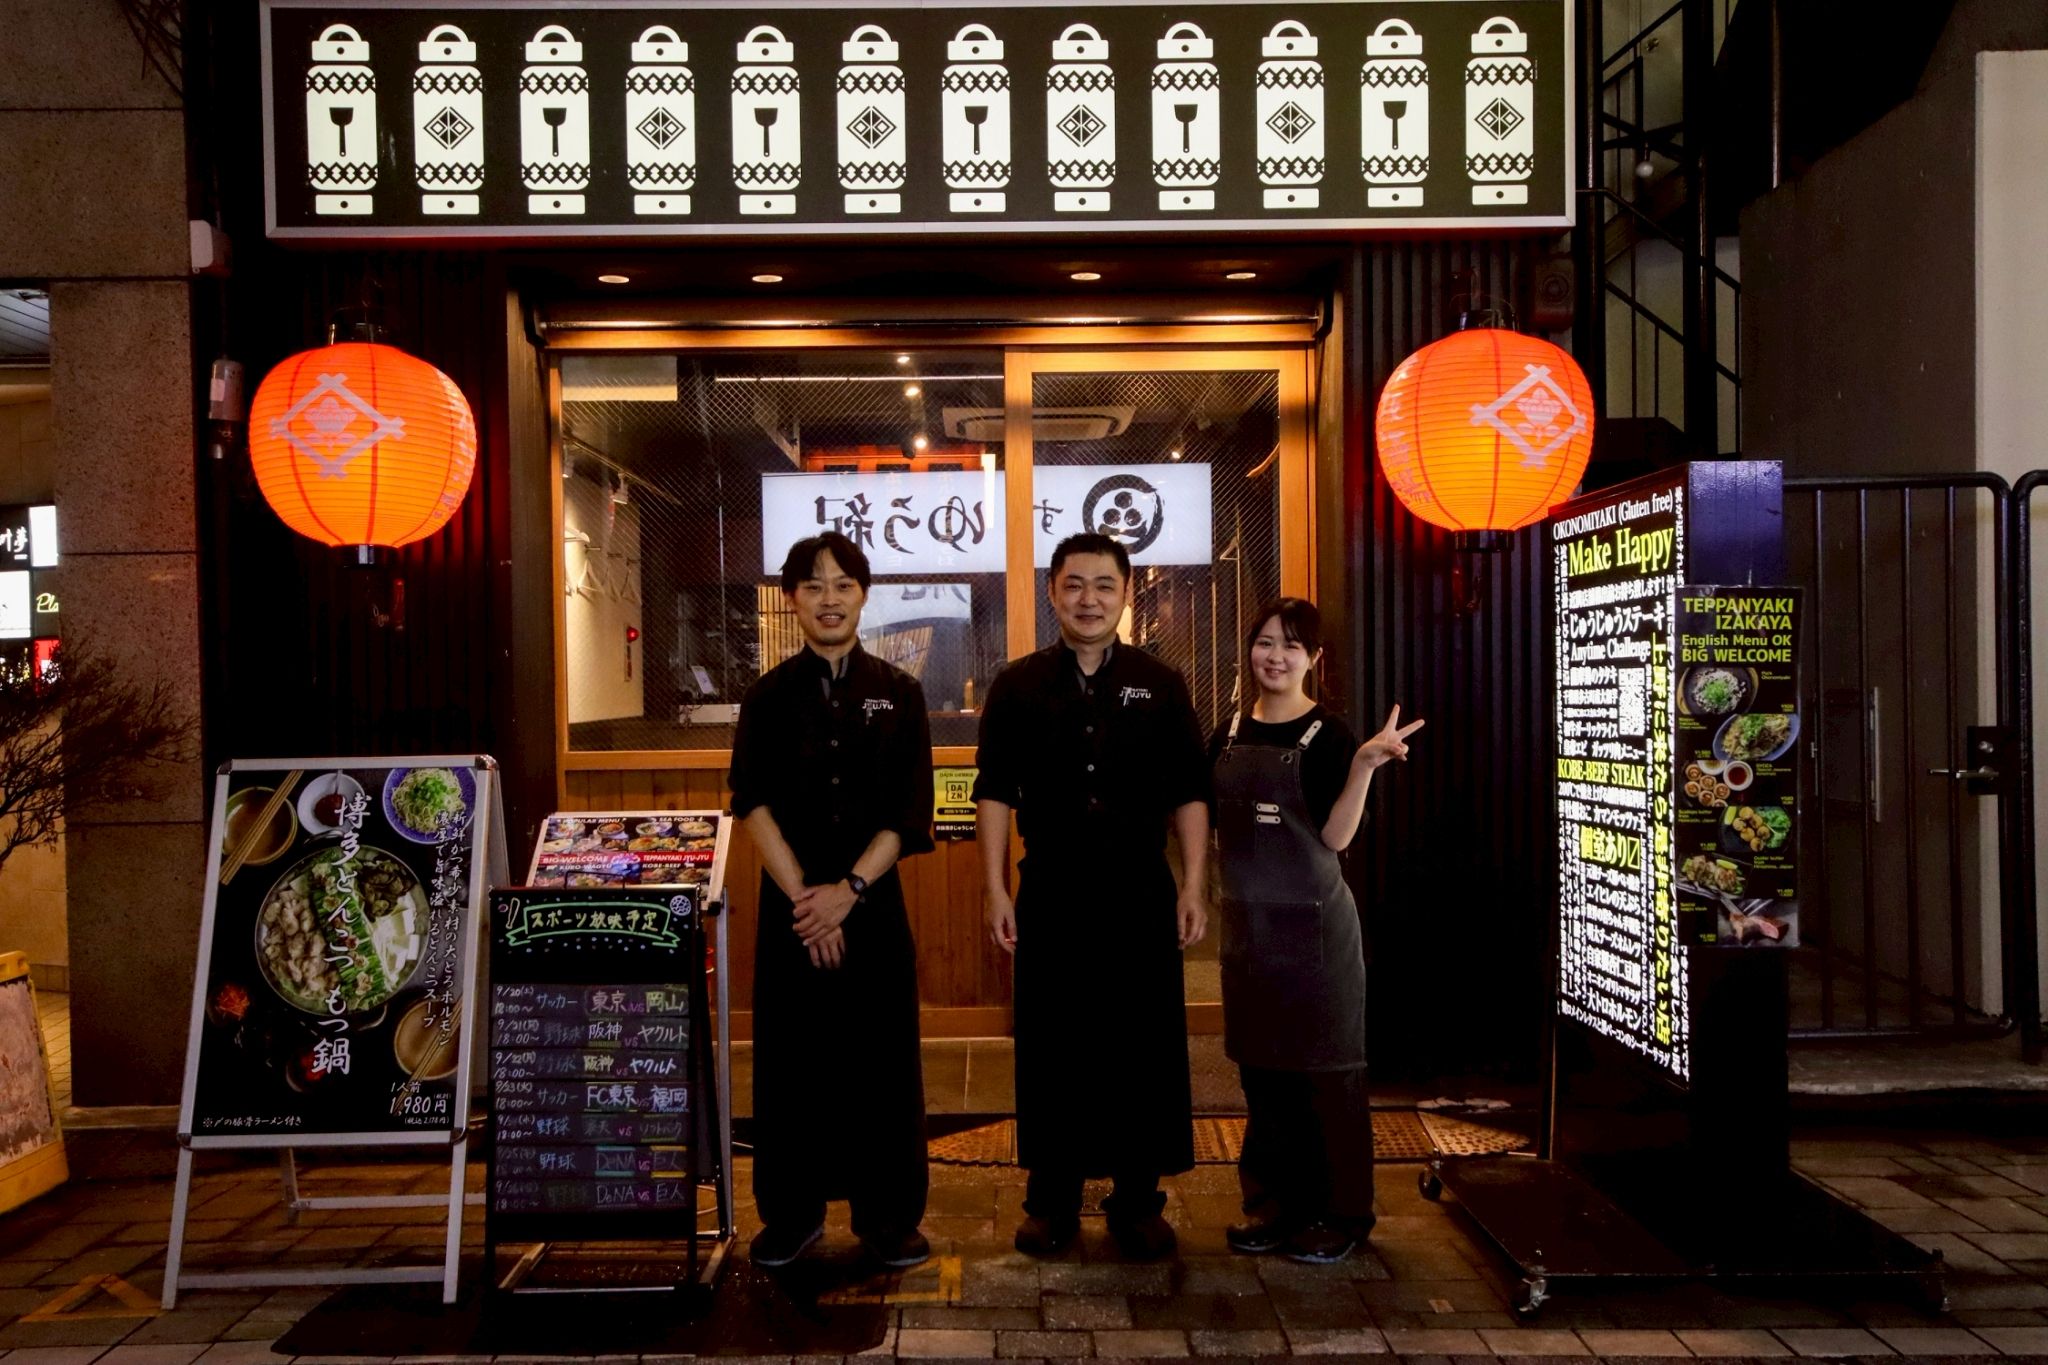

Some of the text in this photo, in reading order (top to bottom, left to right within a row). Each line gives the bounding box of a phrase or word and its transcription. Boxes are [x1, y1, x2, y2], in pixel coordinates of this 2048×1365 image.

[1553, 493, 1673, 540] OKONOMIYAKI (Gluten free)
[1568, 527, 1674, 577] Make Happy
[1682, 598, 1793, 613] TEPPANYAKI
[1570, 601, 1664, 640] じゅうじゅうステーキ
[1716, 615, 1792, 630] IZAKAYA
[1682, 634, 1792, 648] English Menu OK
[1682, 649, 1792, 662] BIG WELCOME
[1558, 758, 1645, 788] KOBE-BEEF STEAK
[1587, 987, 1641, 1031] 大トロホルモン
[391, 1081, 422, 1095] 1人前
